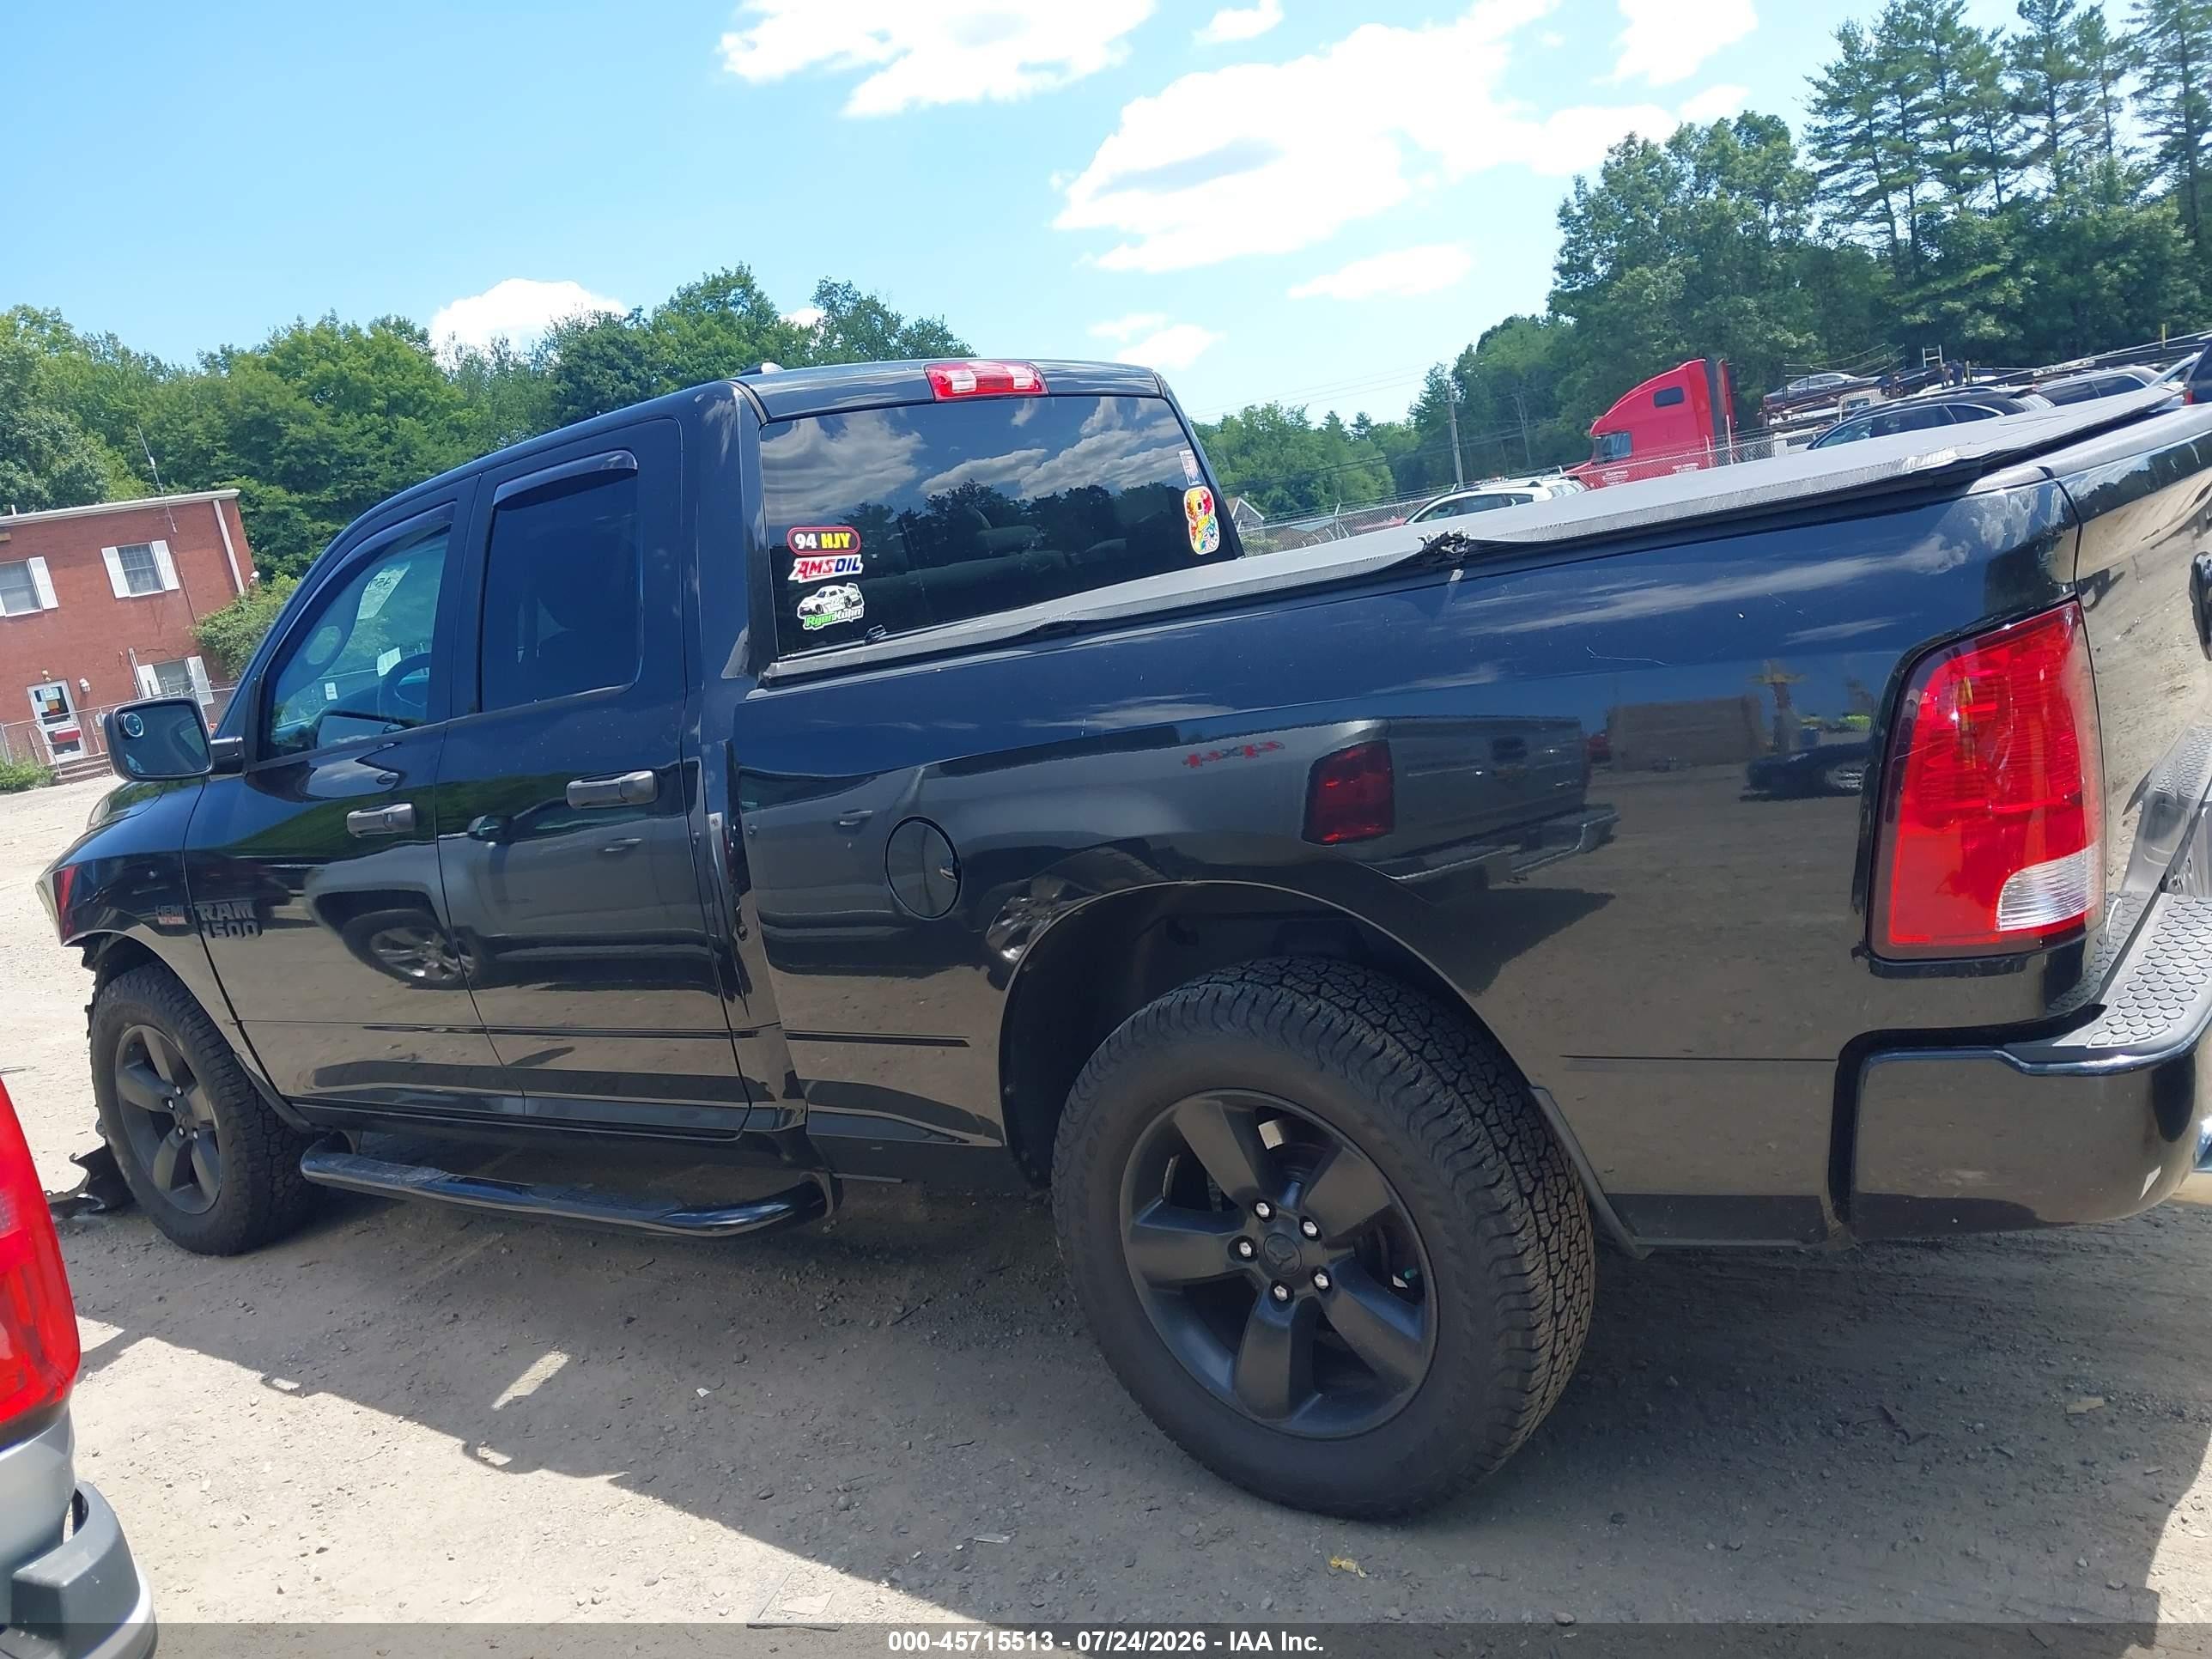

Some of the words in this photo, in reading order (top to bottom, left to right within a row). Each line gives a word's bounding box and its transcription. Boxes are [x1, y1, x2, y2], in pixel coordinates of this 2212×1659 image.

[794, 533, 817, 550] 94
[821, 532, 851, 549] HJY
[794, 558, 860, 579] AMSOIL
[196, 902, 256, 921] RAM
[201, 920, 262, 939] 1500
